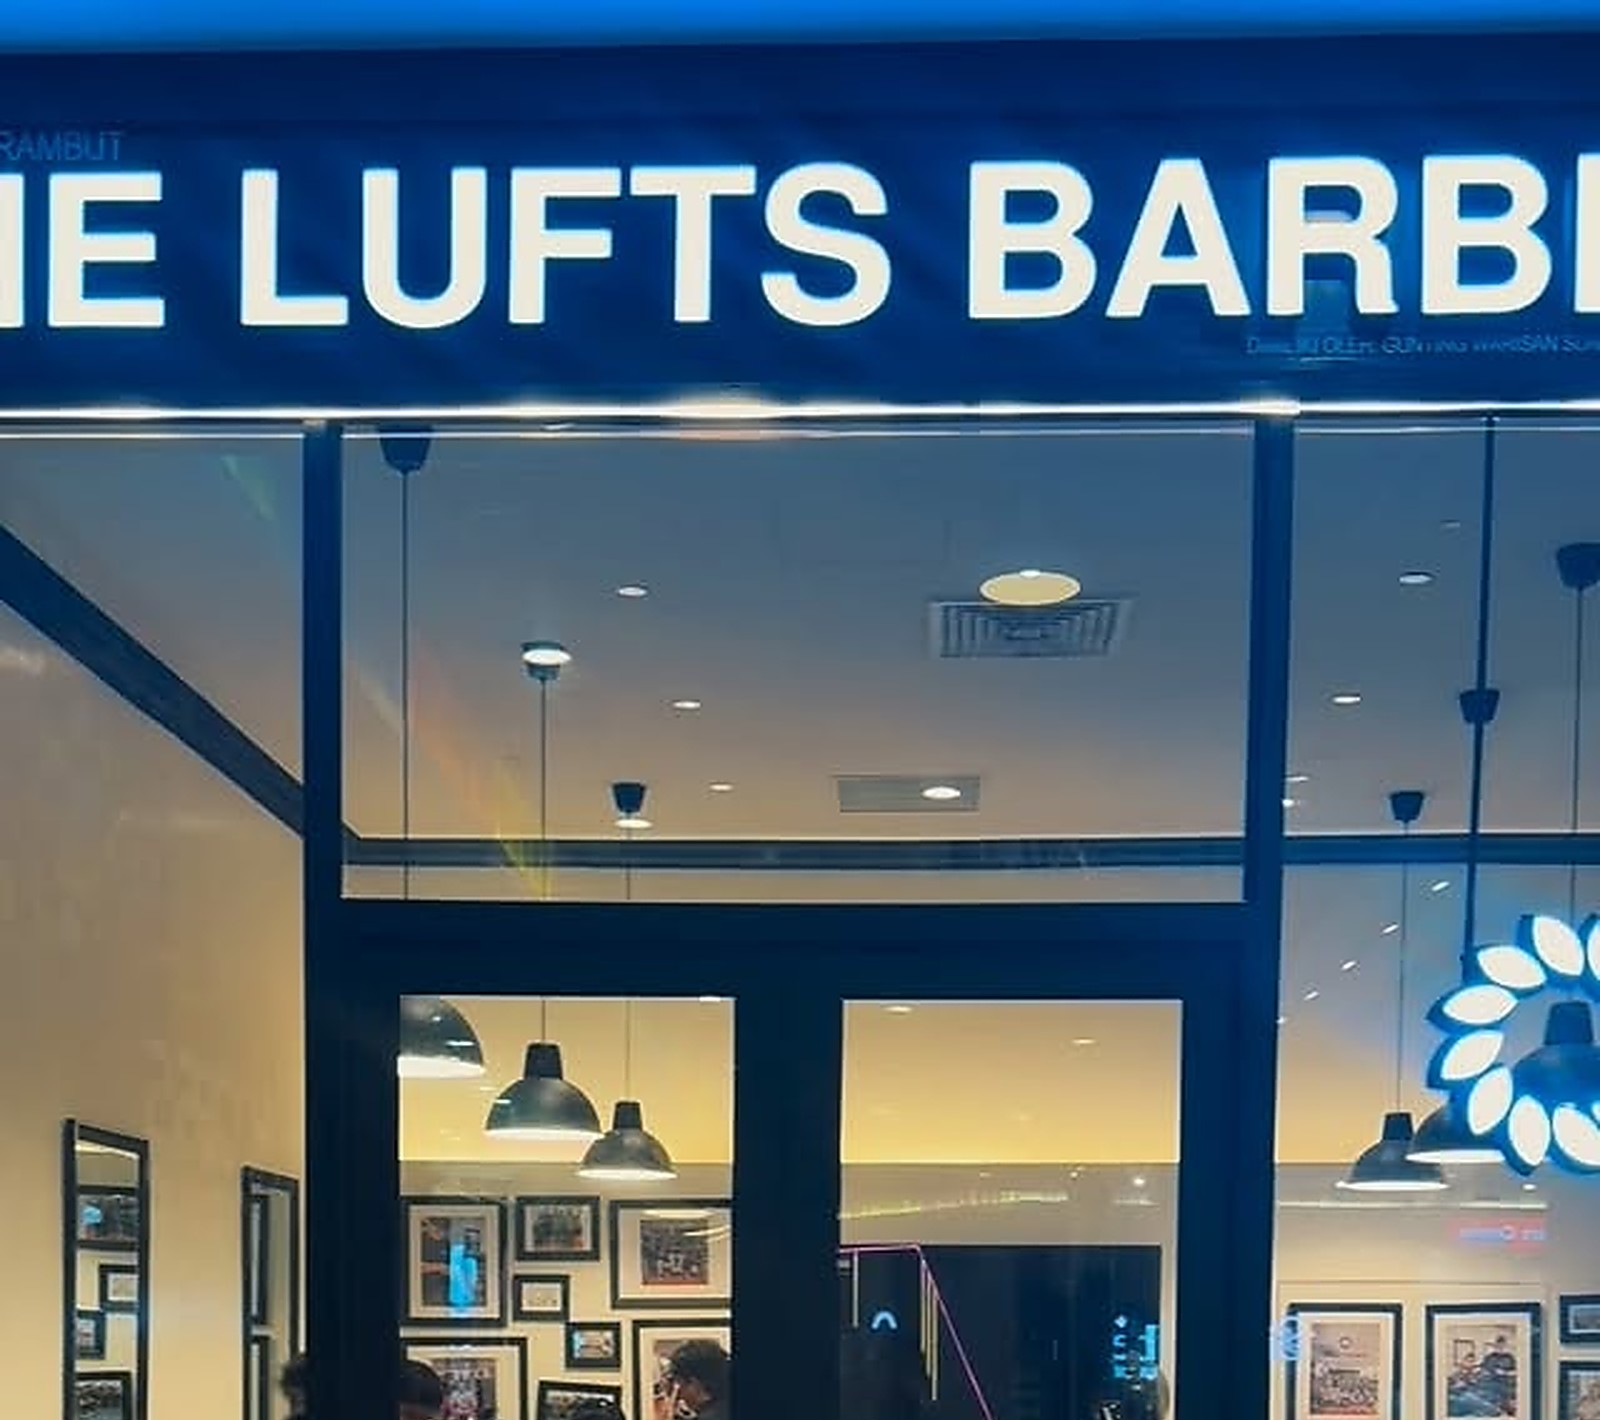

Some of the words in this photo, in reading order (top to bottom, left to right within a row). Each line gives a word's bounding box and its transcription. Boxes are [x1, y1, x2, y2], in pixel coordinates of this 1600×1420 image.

[0, 173, 164, 328] E
[240, 163, 890, 330] LUFTS
[968, 154, 1600, 319] BARB
